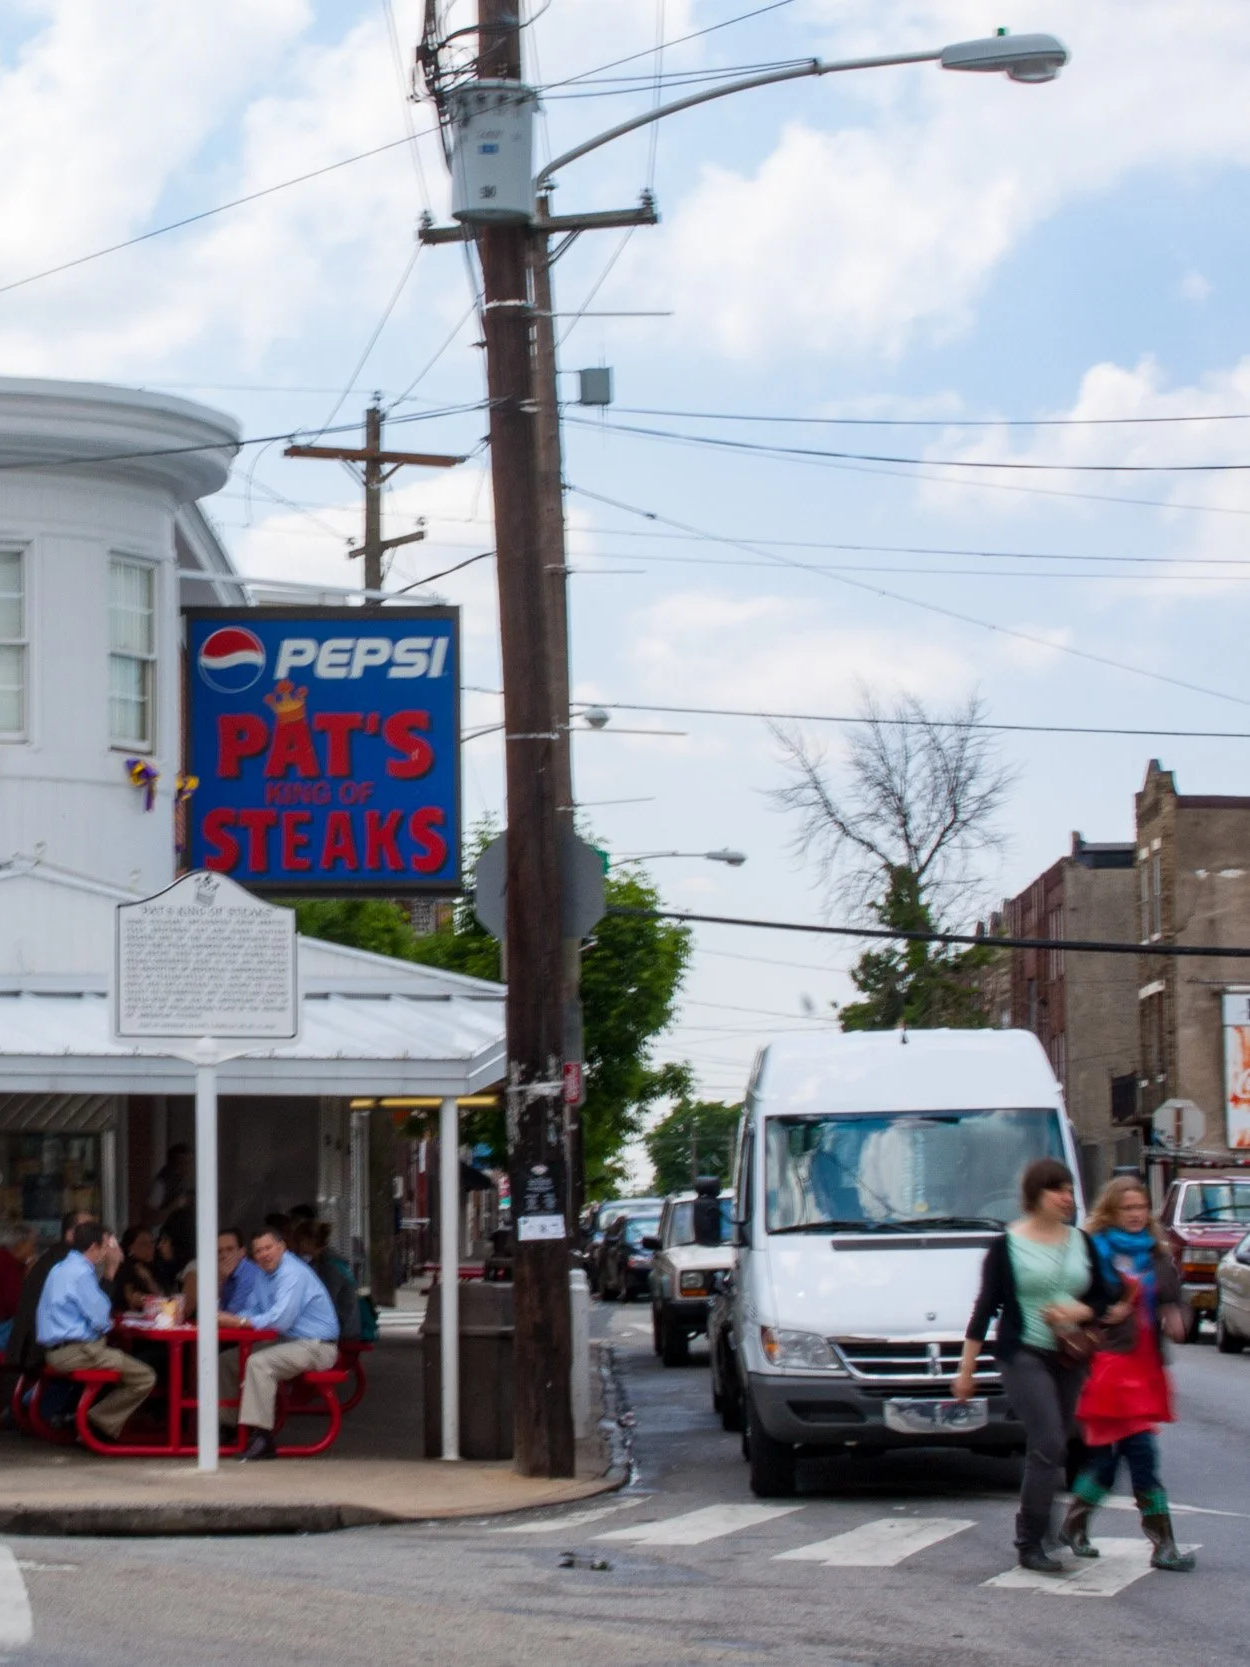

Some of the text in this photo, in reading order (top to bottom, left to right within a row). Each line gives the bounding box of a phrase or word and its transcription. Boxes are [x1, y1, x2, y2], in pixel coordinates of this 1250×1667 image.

[272, 636, 449, 680] PEPSI
[216, 709, 434, 781] PAT'S
[265, 782, 377, 806] KING OF
[201, 806, 449, 875] STEAKS
